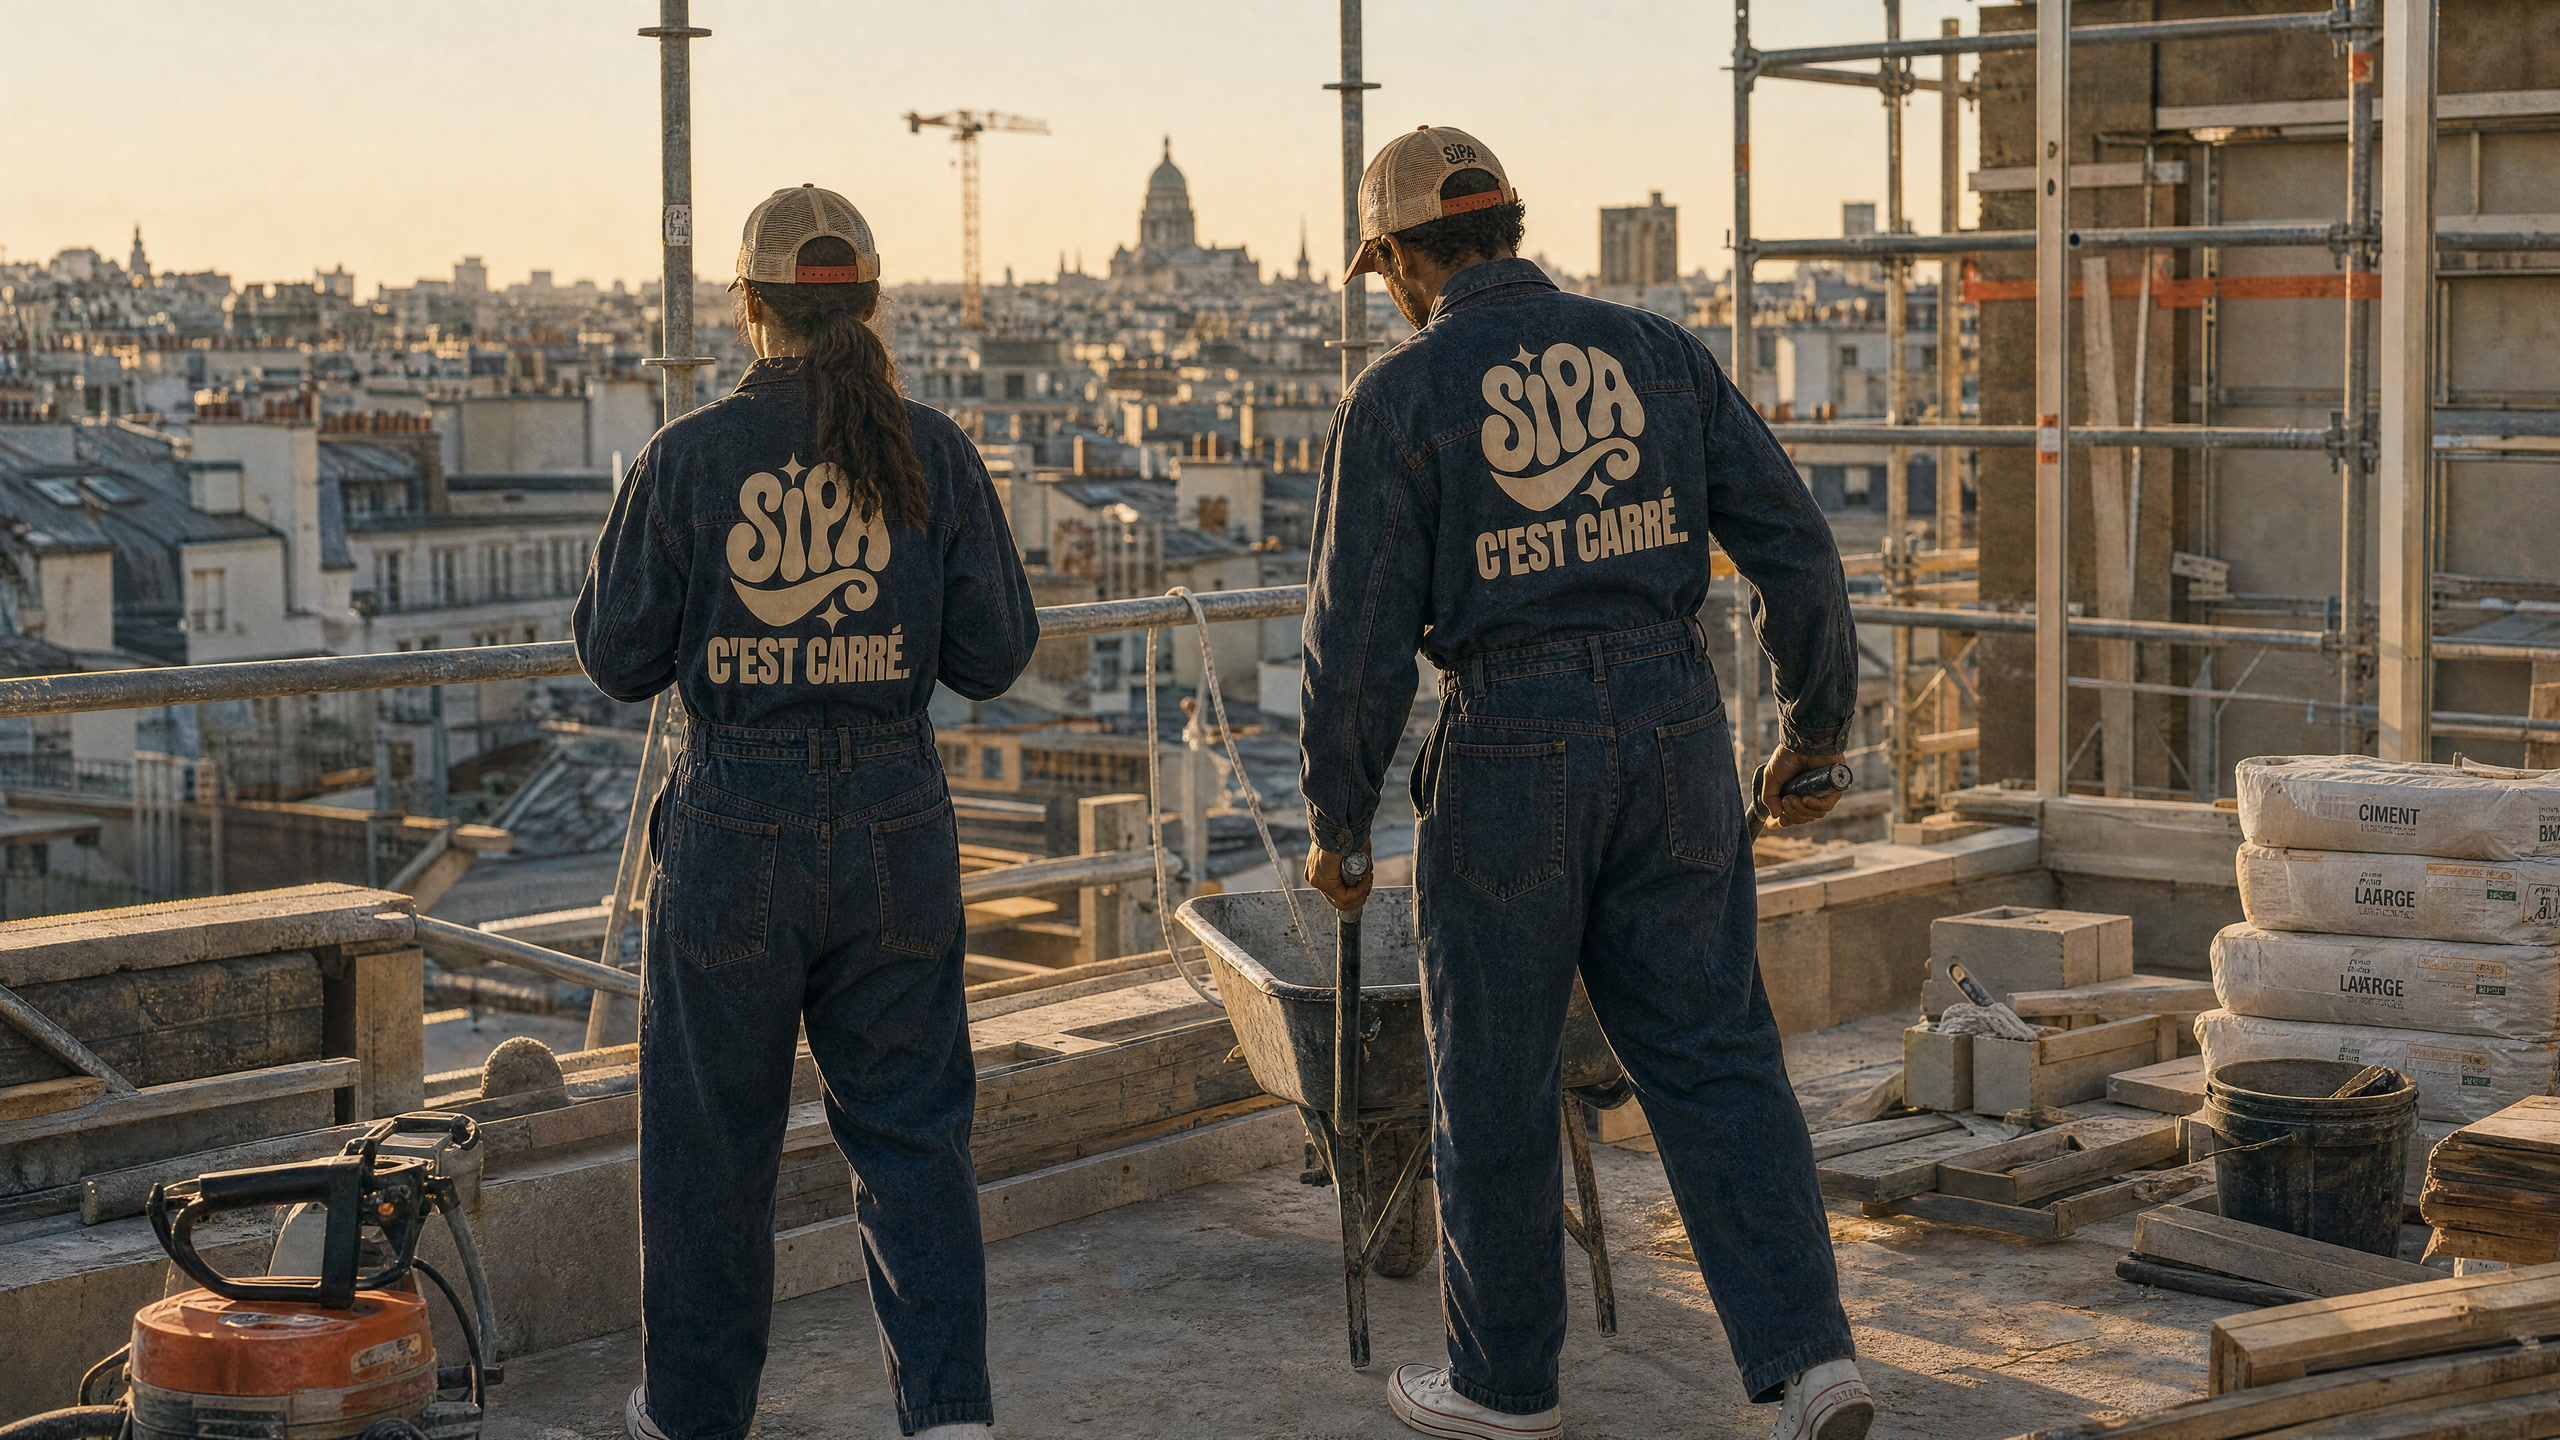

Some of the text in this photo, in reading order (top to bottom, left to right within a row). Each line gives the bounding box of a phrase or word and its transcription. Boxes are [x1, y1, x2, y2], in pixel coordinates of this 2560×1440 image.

[1475, 486, 1689, 580] C'EST CARRÉ.
[707, 623, 911, 685] C'EST CARRÉ.
[2359, 804, 2420, 826] CIMENT
